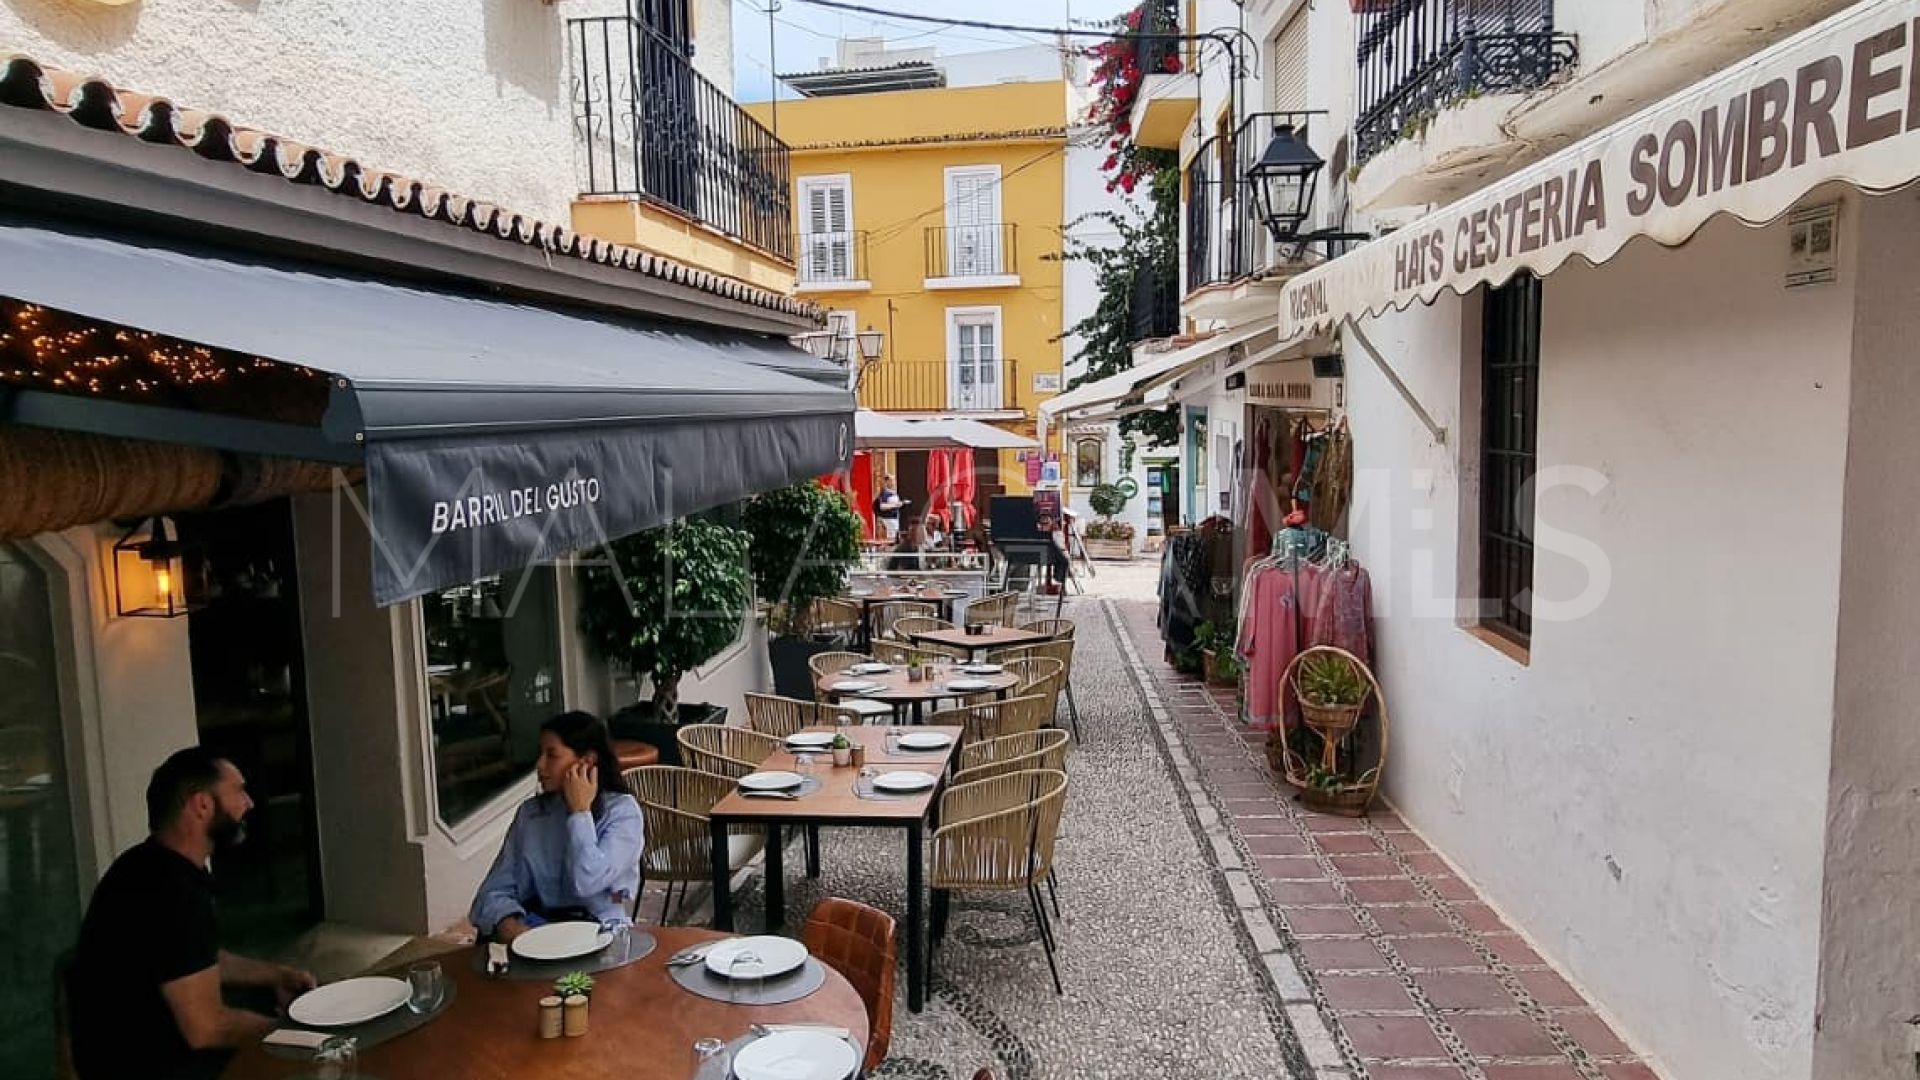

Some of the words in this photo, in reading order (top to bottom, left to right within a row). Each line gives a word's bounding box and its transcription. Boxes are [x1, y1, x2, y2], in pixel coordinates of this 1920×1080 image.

[1395, 229, 1443, 292] HATS
[1453, 159, 1606, 274] CESTERIA
[1626, 17, 1920, 216] SOMBRE
[432, 493, 509, 533] BARRIL
[510, 486, 542, 518] DEL
[546, 478, 599, 510] GUSTO
